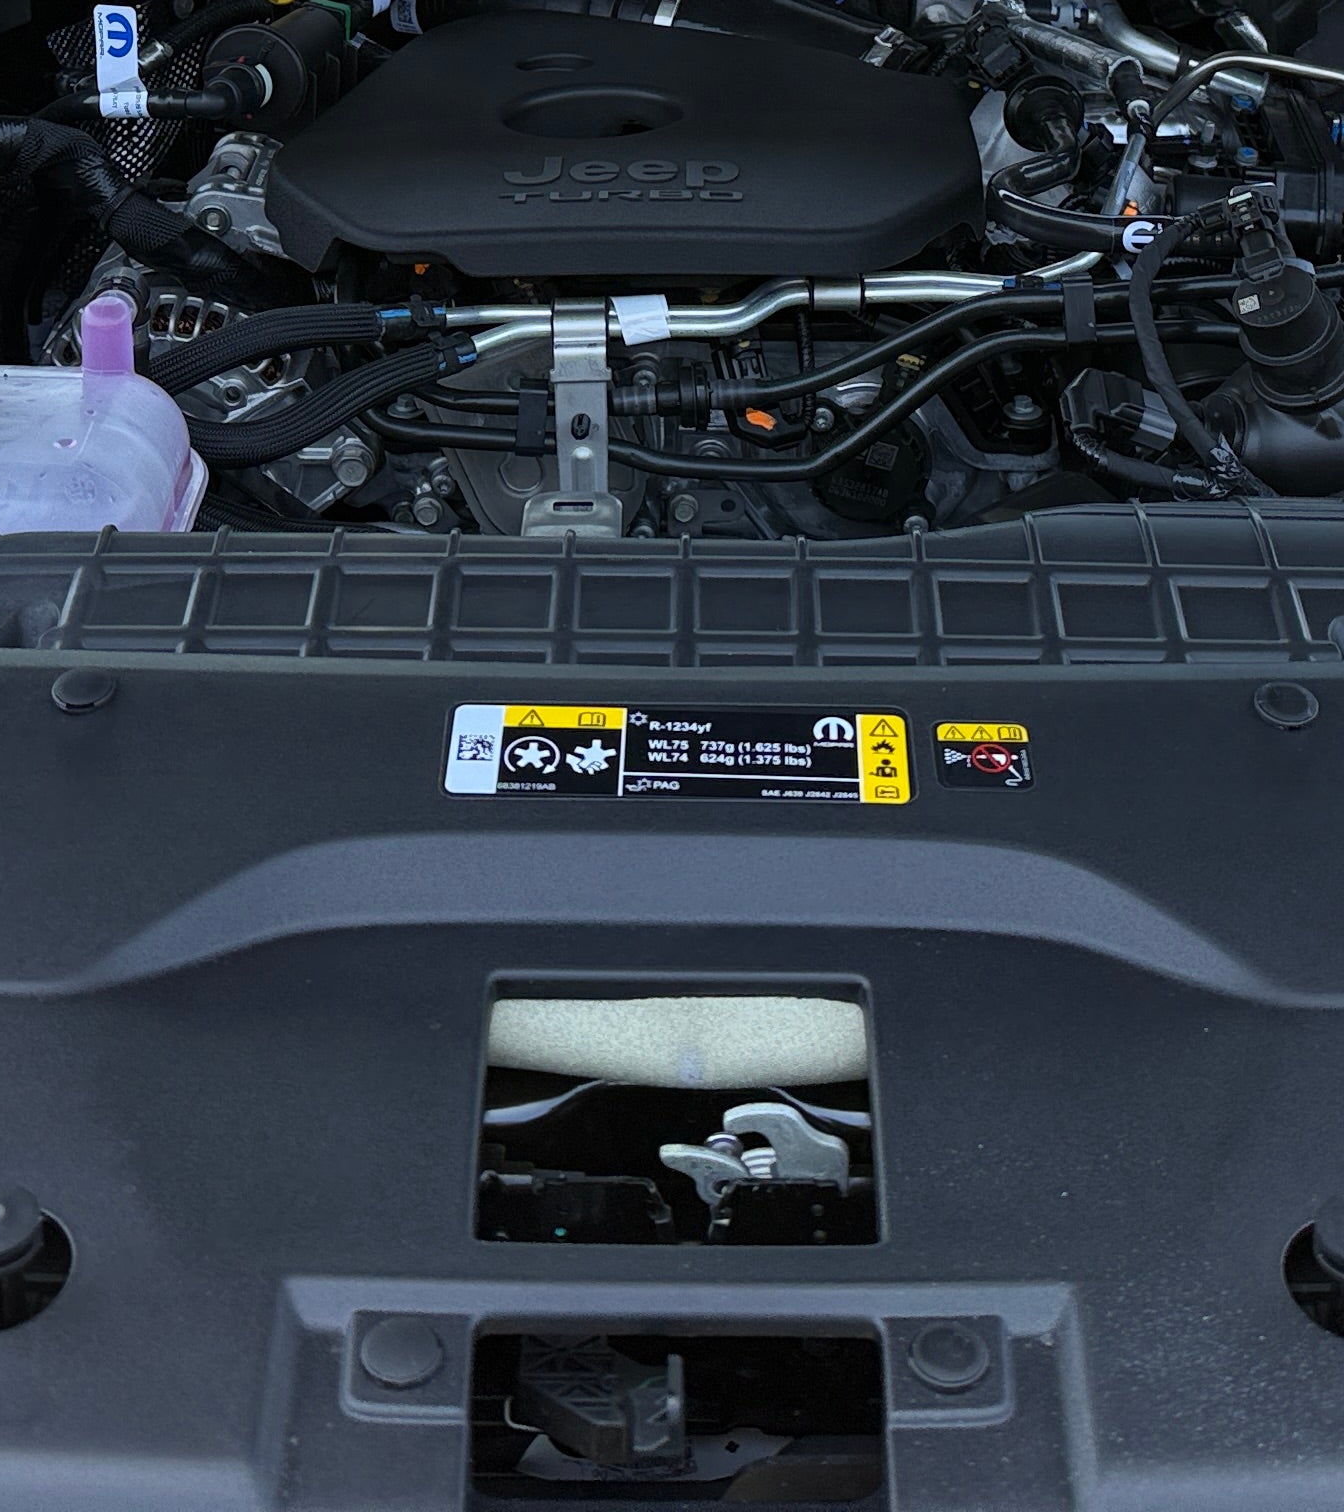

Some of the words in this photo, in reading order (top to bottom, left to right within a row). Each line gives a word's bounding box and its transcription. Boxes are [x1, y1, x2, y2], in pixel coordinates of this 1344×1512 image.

[502, 155, 741, 188] Jeep
[498, 188, 744, 204] TURBO
[649, 720, 712, 734] R-1234yf
[648, 739, 689, 750] WL75
[700, 740, 735, 754] 737g
[738, 741, 781, 753] (1.625
[784, 743, 811, 755] lbs)
[648, 751, 689, 762] WL74
[700, 753, 735, 766] 624g
[738, 754, 781, 766] (1.375
[784, 755, 812, 768] lbs)
[652, 780, 680, 790] PAG
[761, 789, 781, 797] SAE
